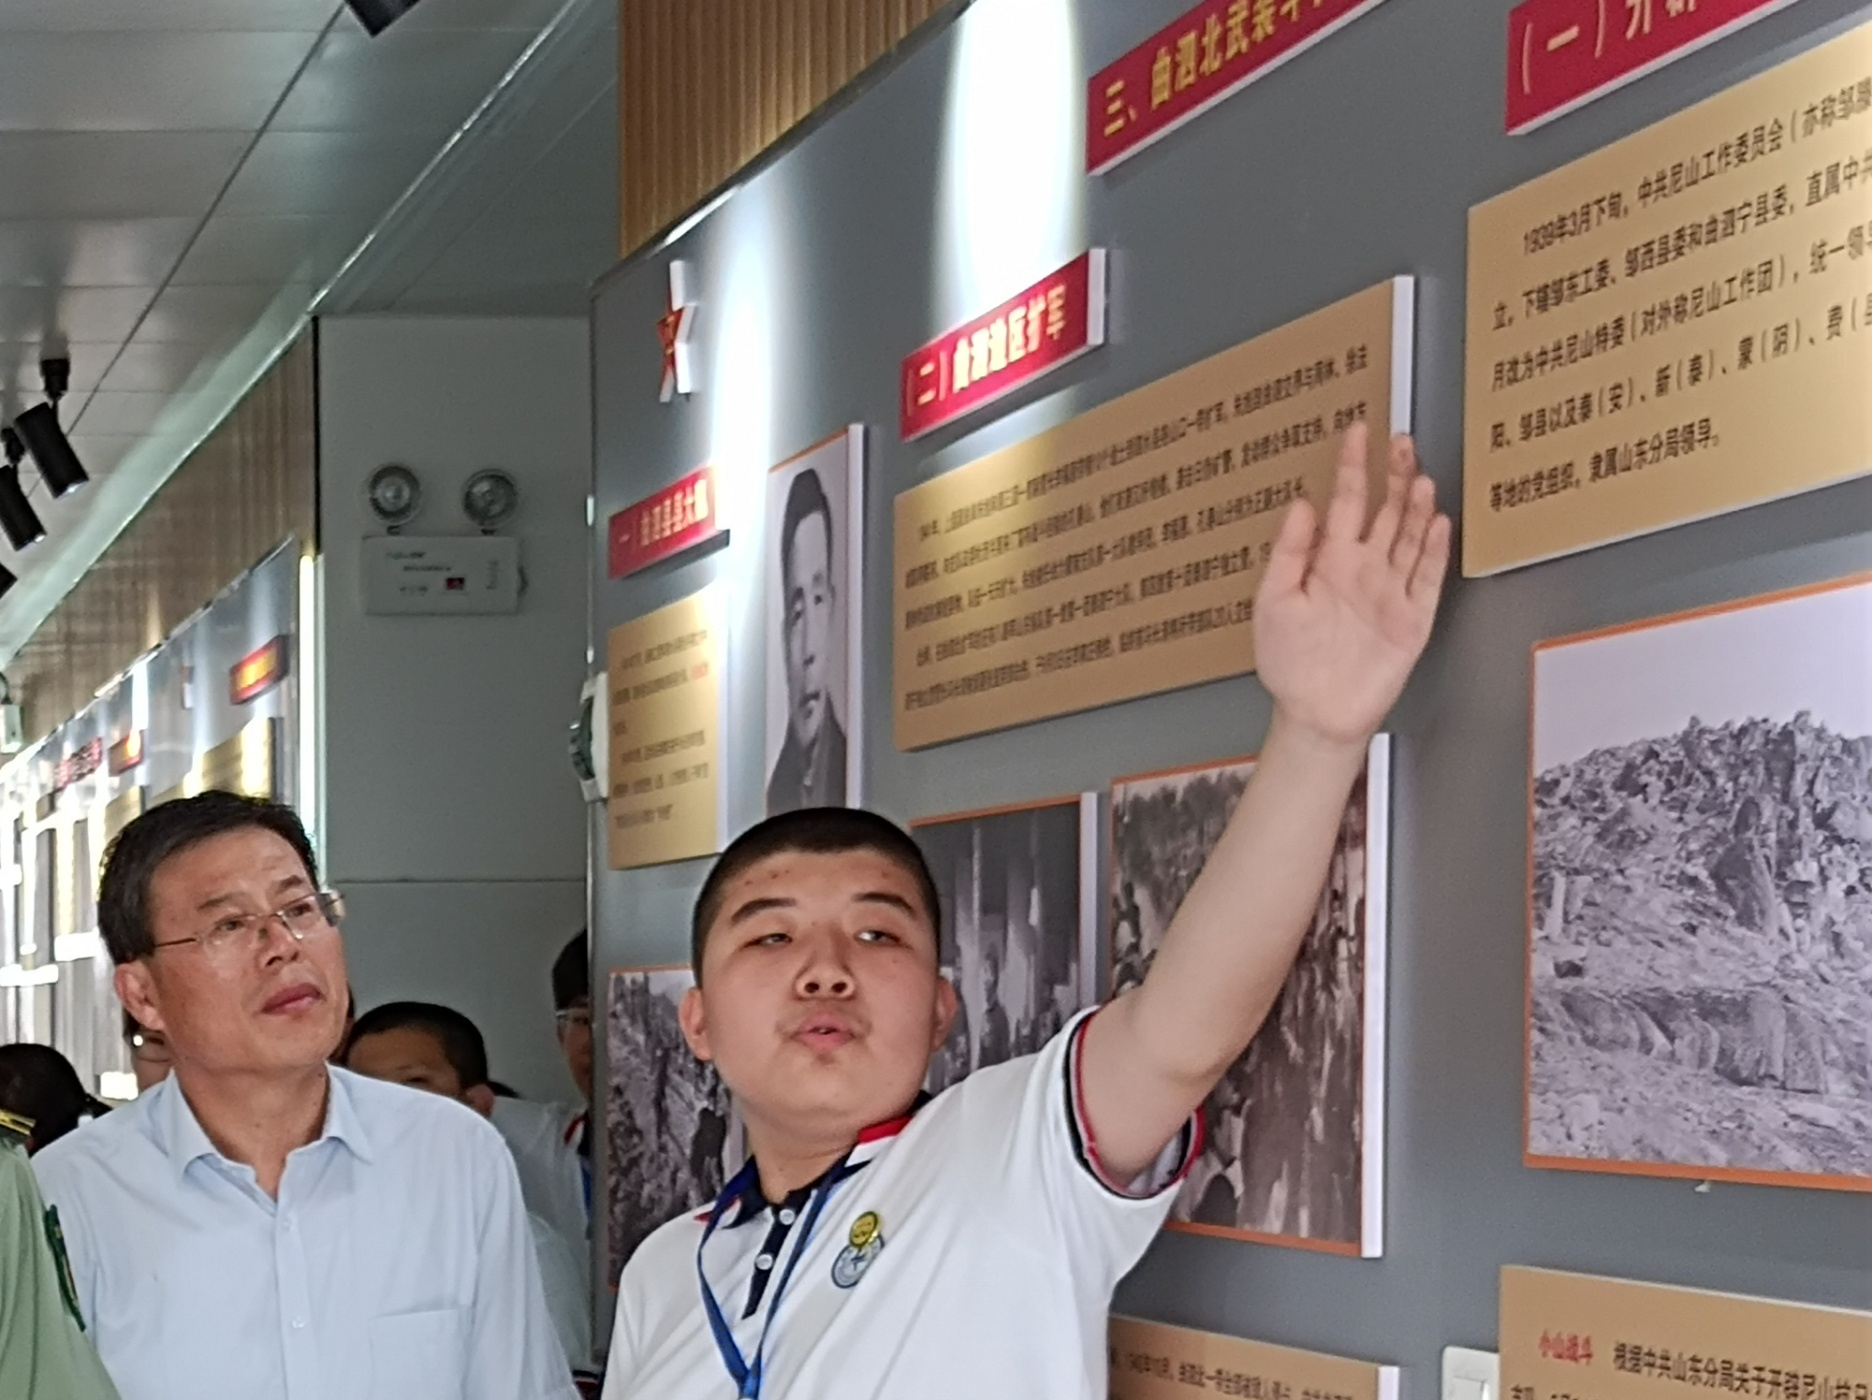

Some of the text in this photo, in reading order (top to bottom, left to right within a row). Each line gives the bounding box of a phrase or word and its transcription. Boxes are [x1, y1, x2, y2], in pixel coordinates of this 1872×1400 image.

[1104, 0, 1323, 137] 三、曲泗北武装
